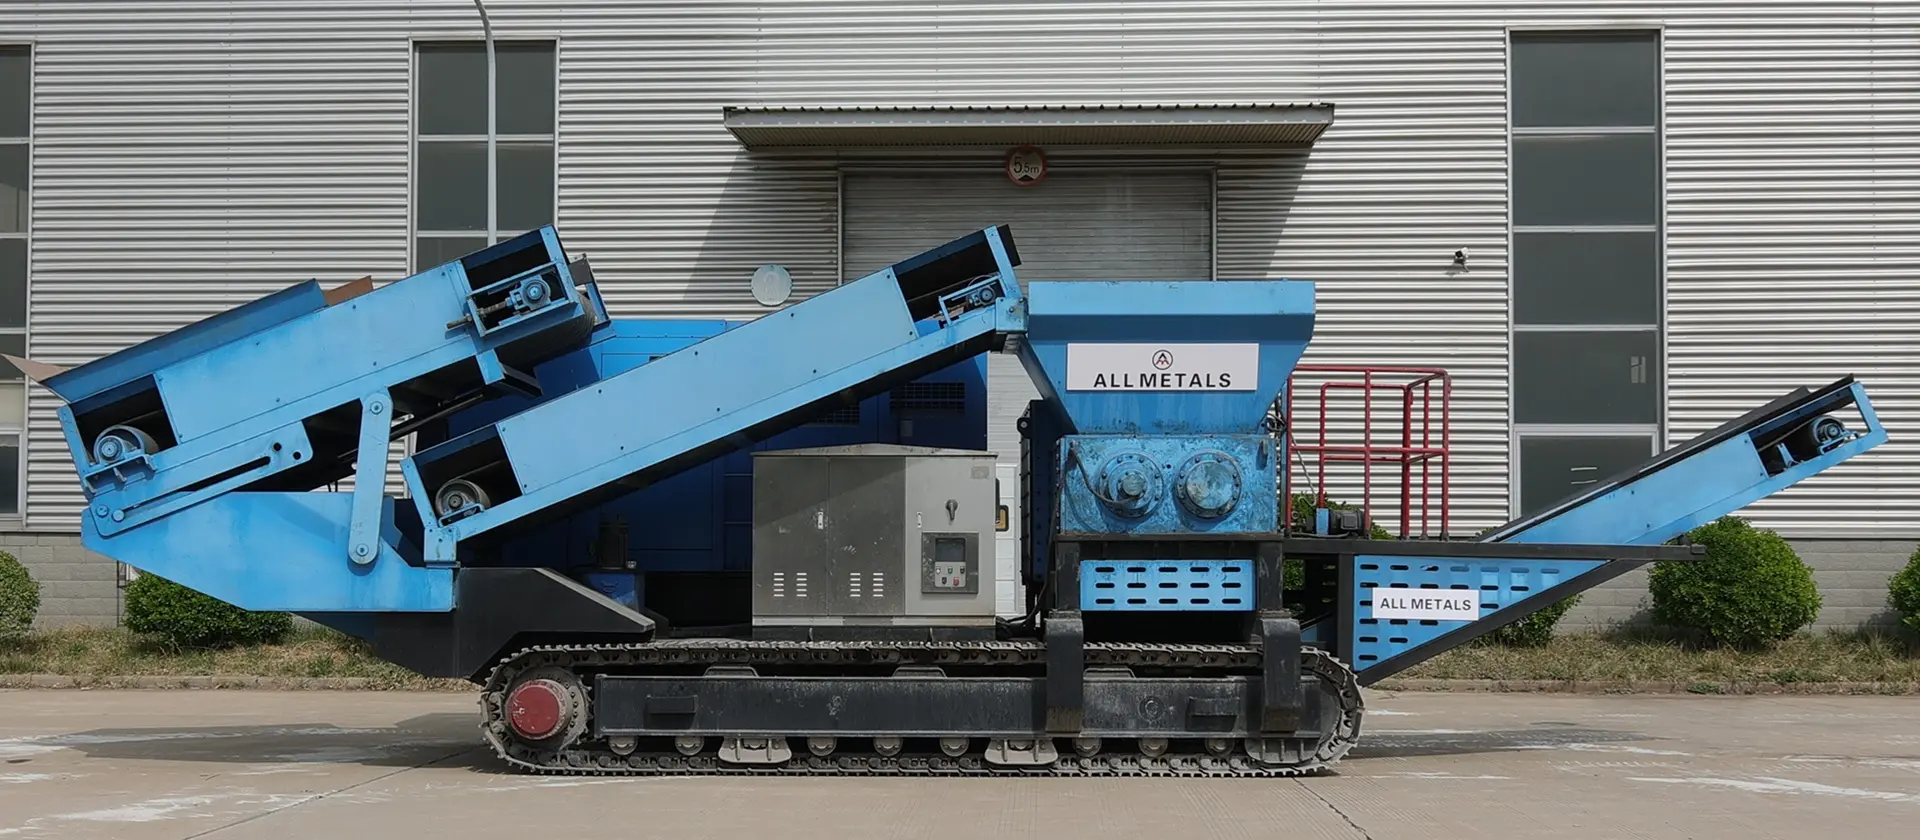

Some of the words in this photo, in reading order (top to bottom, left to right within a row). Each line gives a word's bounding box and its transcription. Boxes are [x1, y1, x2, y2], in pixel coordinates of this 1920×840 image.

[1093, 373, 1134, 388] ALL
[1139, 373, 1232, 388] METALS
[1380, 598, 1407, 609] ALL
[1411, 598, 1471, 611] METALS
